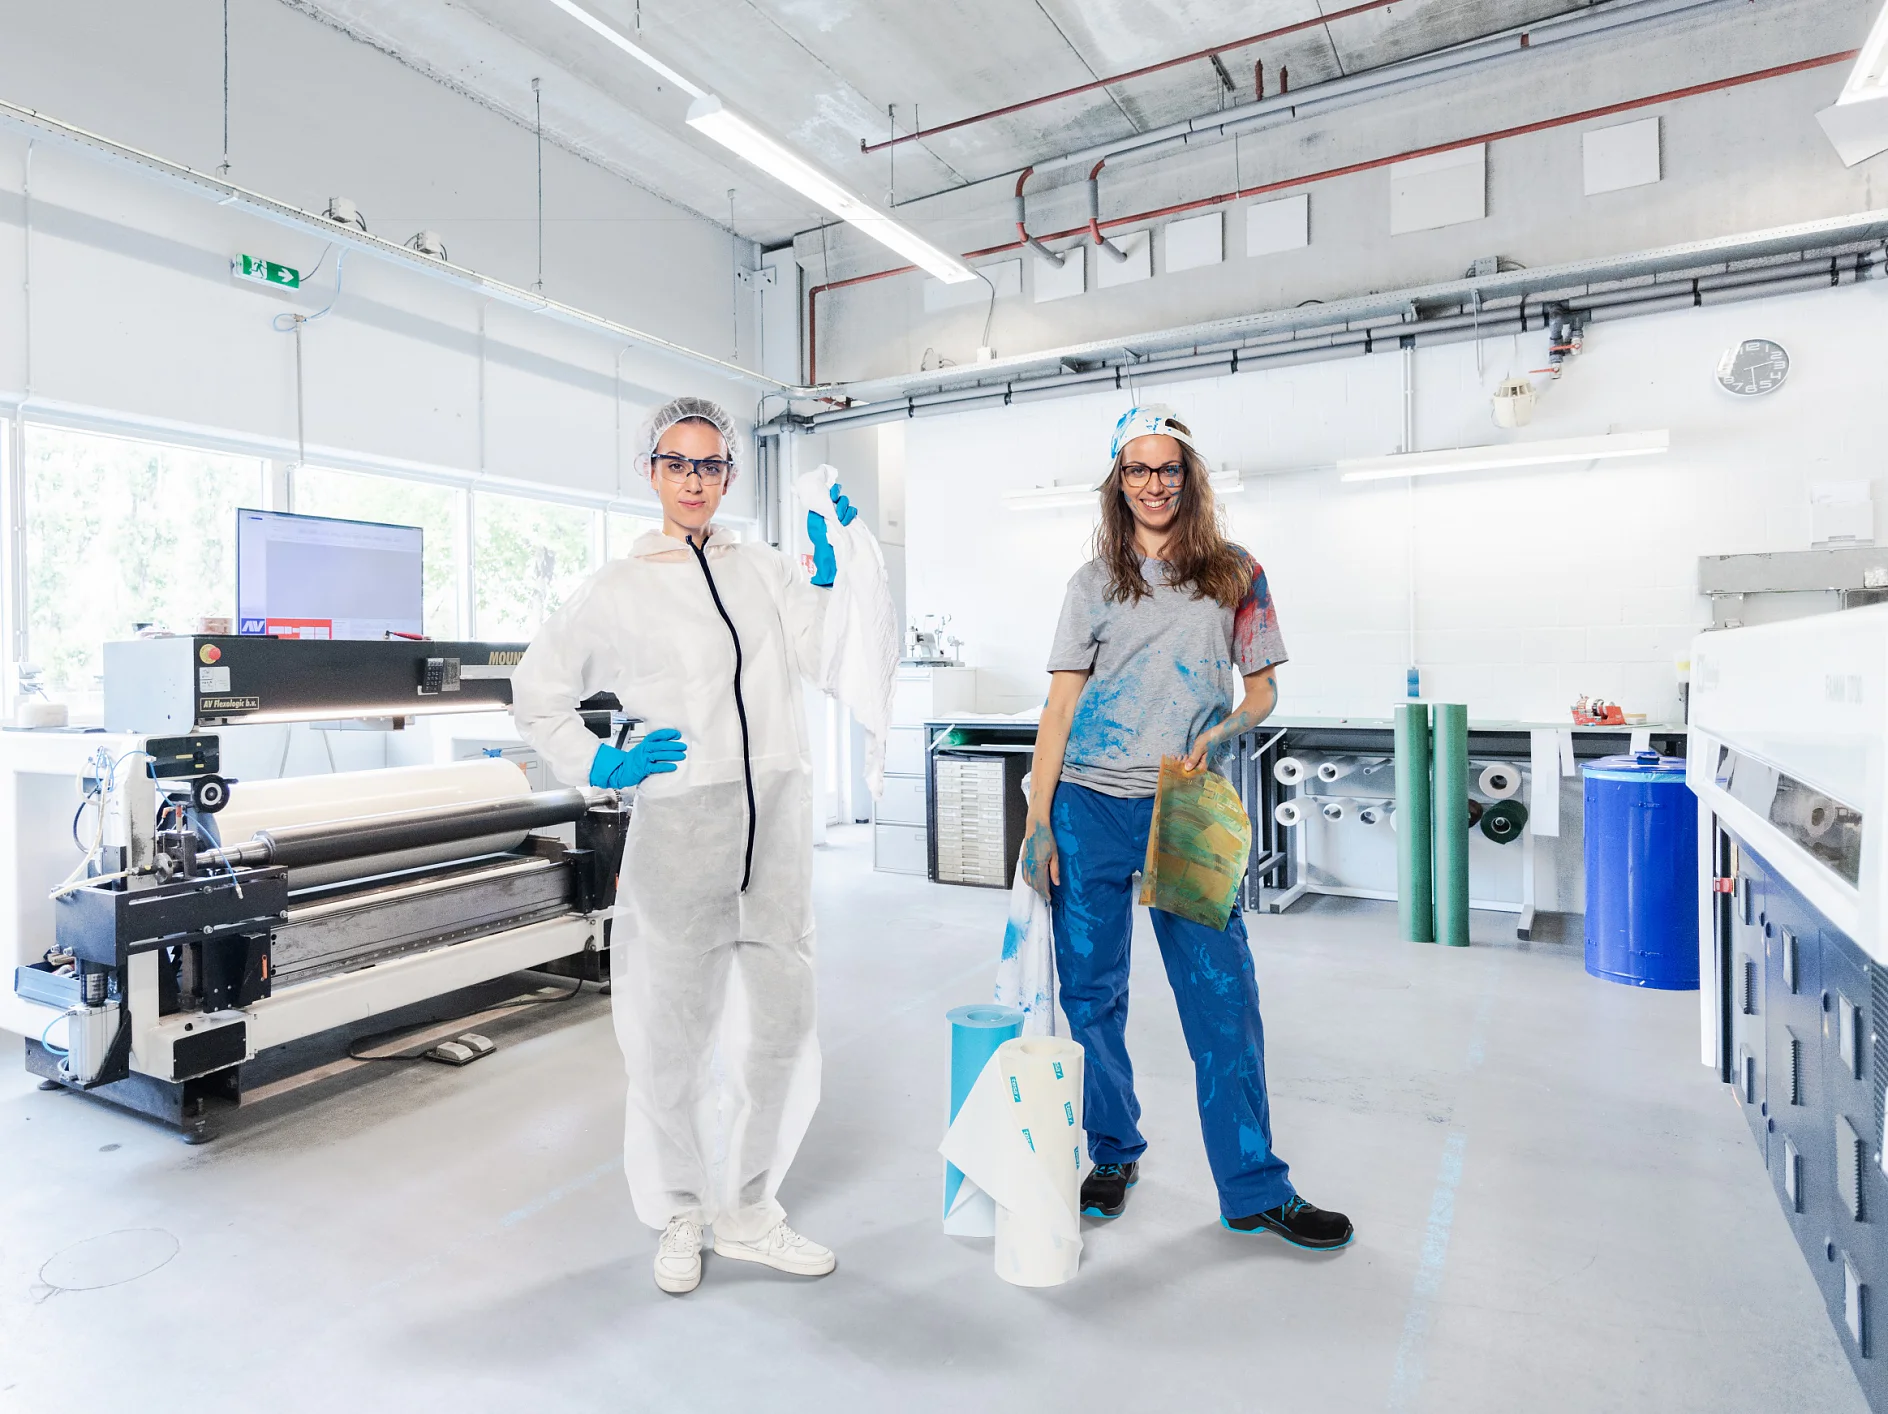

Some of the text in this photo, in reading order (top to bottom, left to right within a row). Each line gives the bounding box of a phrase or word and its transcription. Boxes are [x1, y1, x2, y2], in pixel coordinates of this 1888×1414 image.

[1745, 342, 1760, 351] 12
[1770, 351, 1782, 360] 2
[1773, 361, 1785, 369] 3
[1770, 371, 1781, 379] 4
[1732, 383, 1743, 391] 7
[1759, 380, 1772, 388] 5
[1745, 385, 1757, 393] 6
[241, 620, 265, 632] AV
[203, 700, 213, 709] AV
[213, 699, 245, 709] Flexologic
